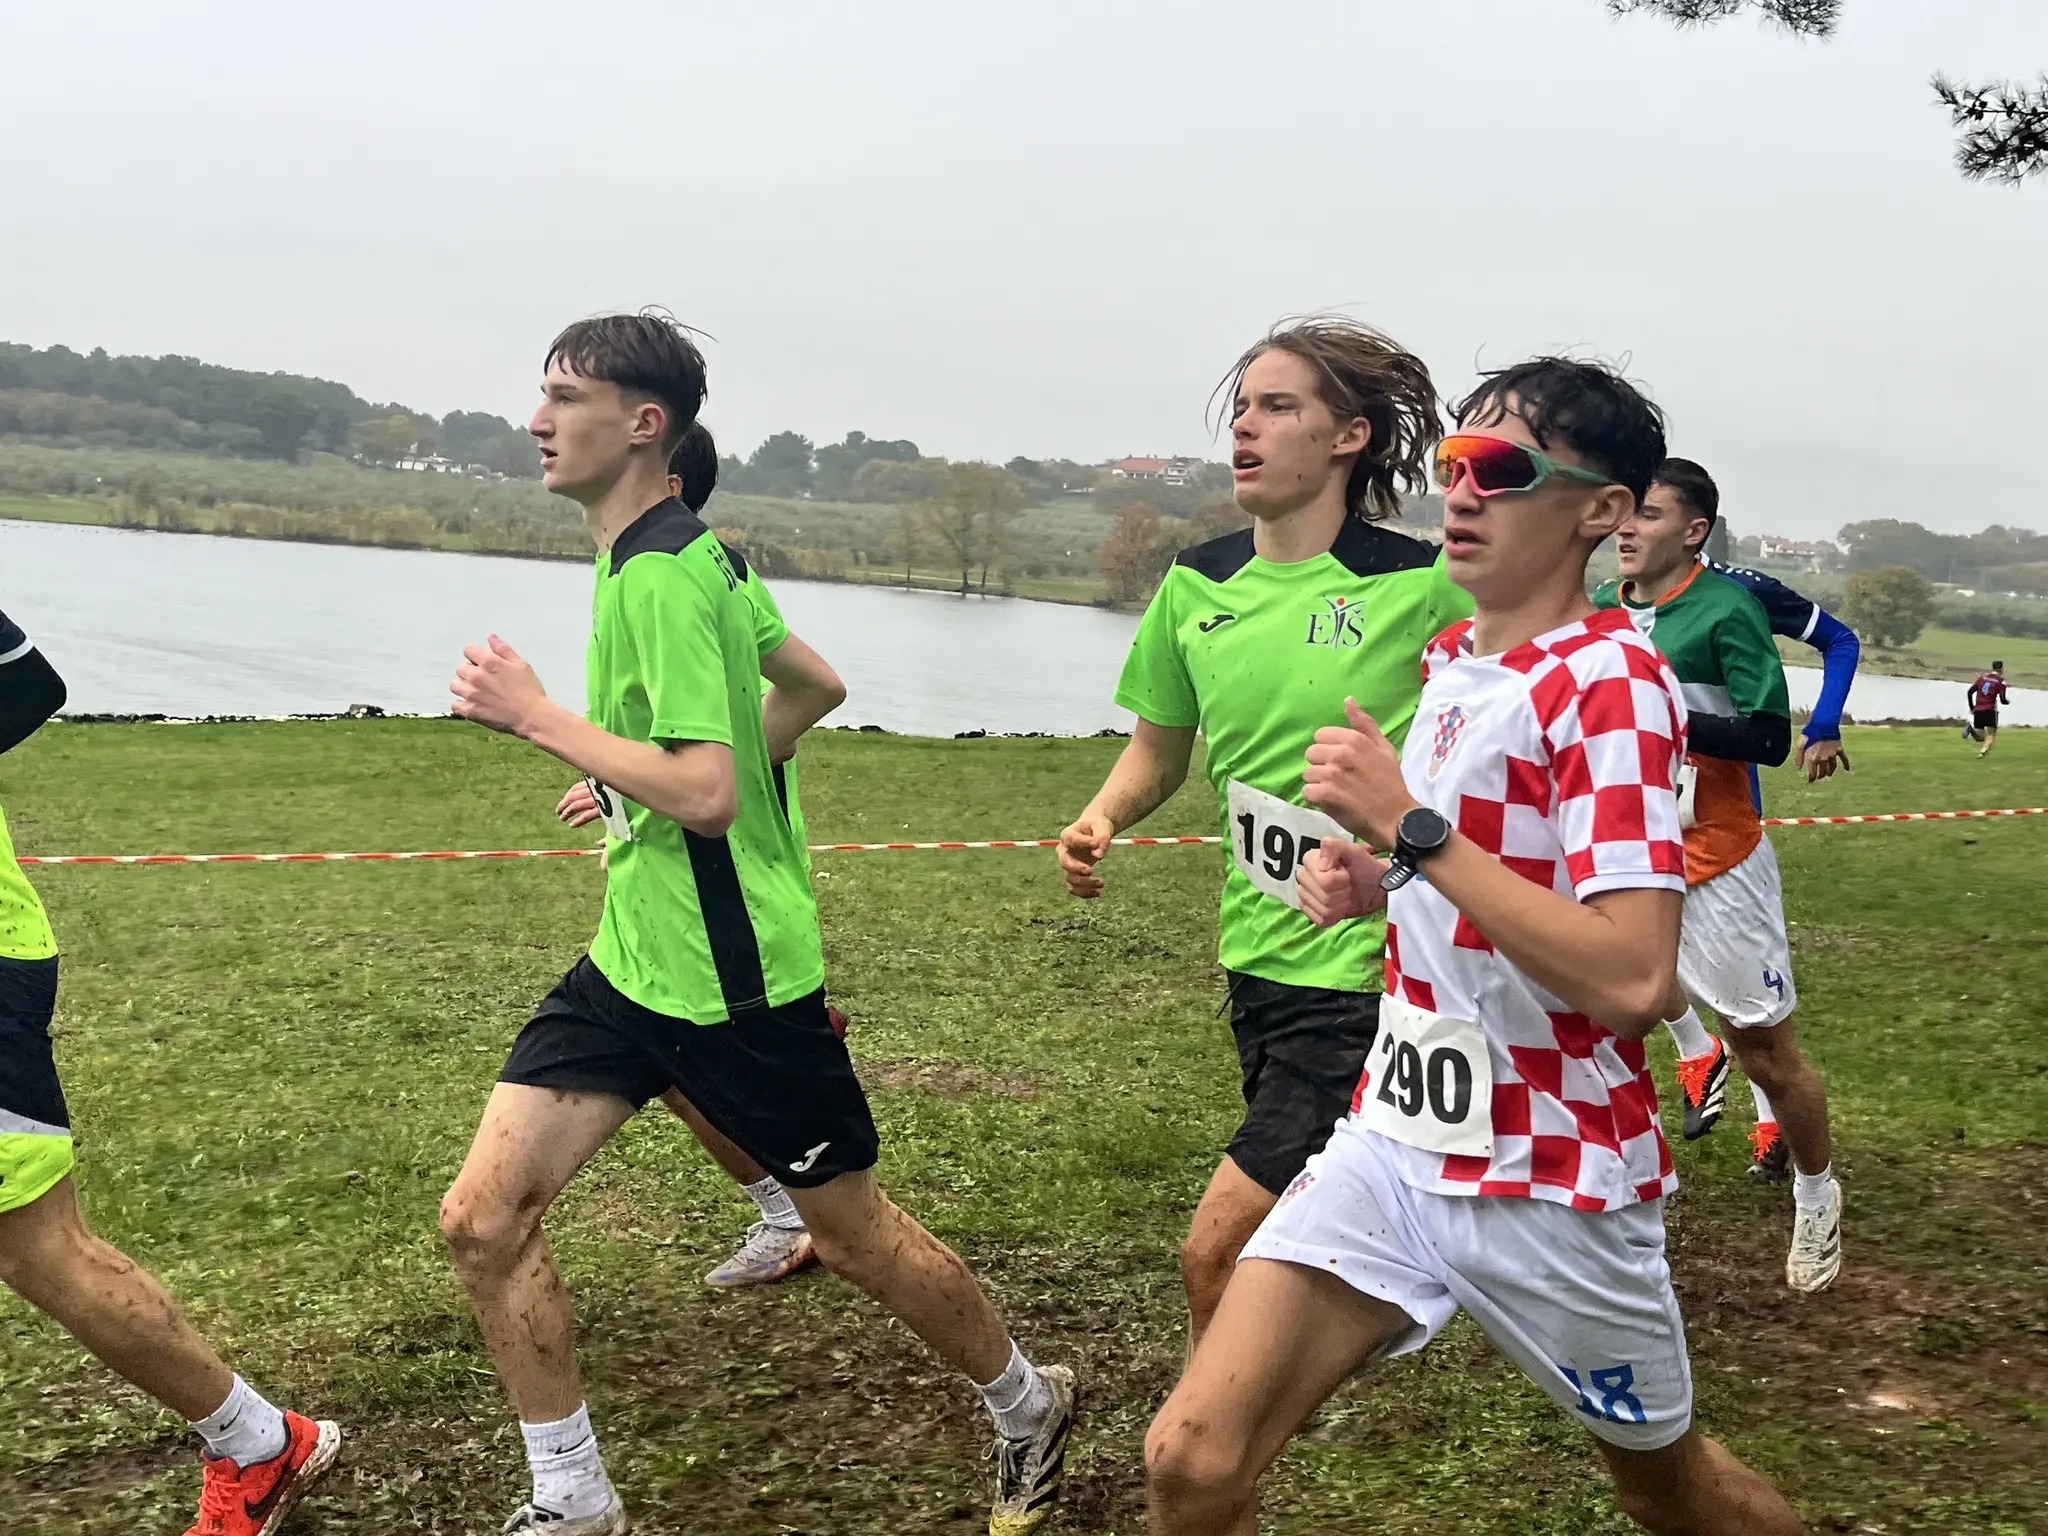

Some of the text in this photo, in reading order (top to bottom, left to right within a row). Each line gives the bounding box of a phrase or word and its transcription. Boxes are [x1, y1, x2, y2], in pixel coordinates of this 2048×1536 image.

[1762, 969, 1784, 1002] 4
[1376, 1031, 1473, 1124] 290
[1556, 1363, 1648, 1425] 18
